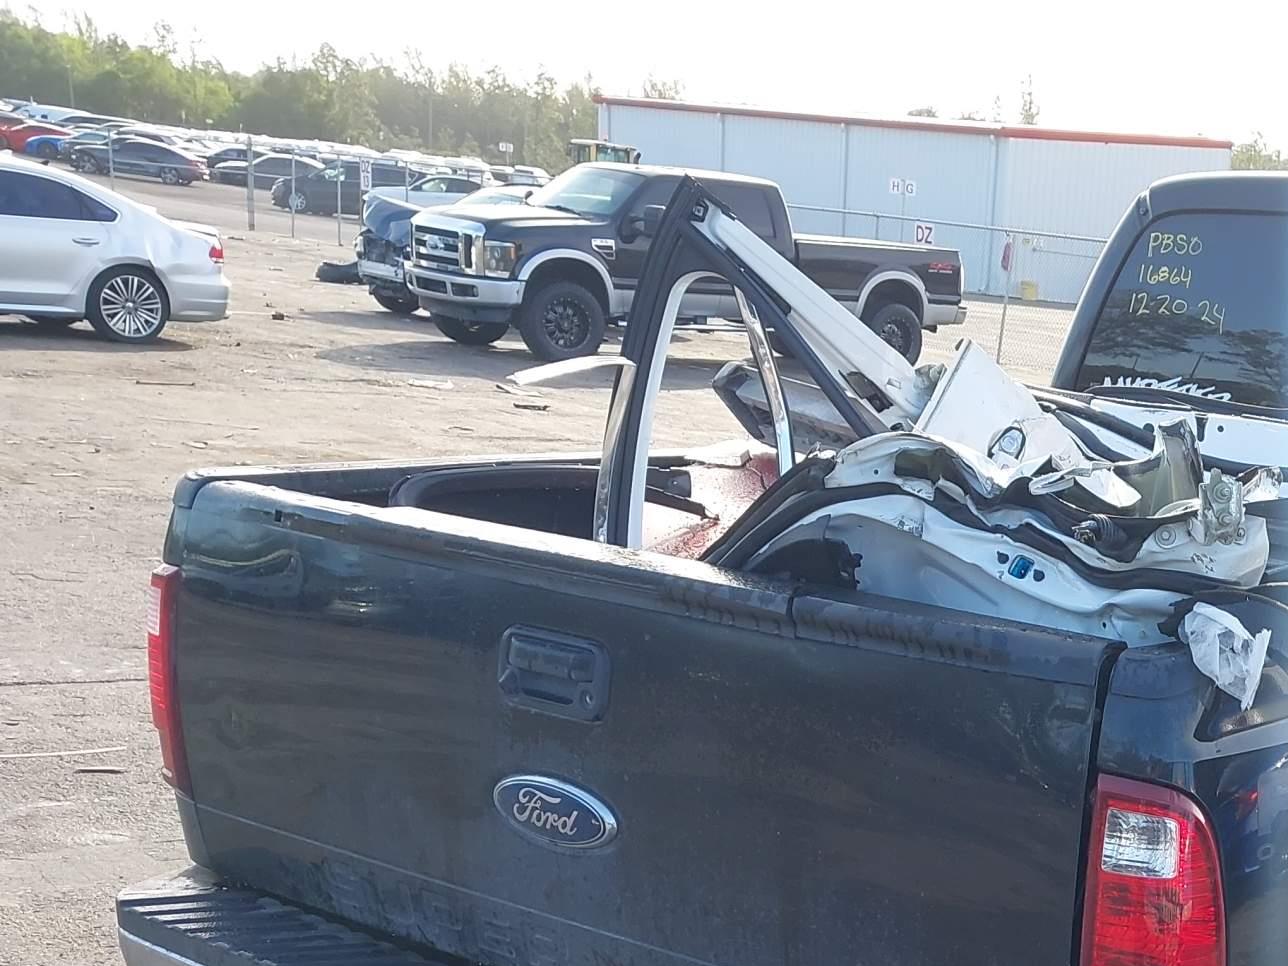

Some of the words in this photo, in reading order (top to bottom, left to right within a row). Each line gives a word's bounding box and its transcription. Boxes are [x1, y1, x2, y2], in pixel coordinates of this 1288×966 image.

[915, 224, 933, 244] DZ
[1138, 264, 1192, 289] 16864
[513, 787, 582, 836] Ford
